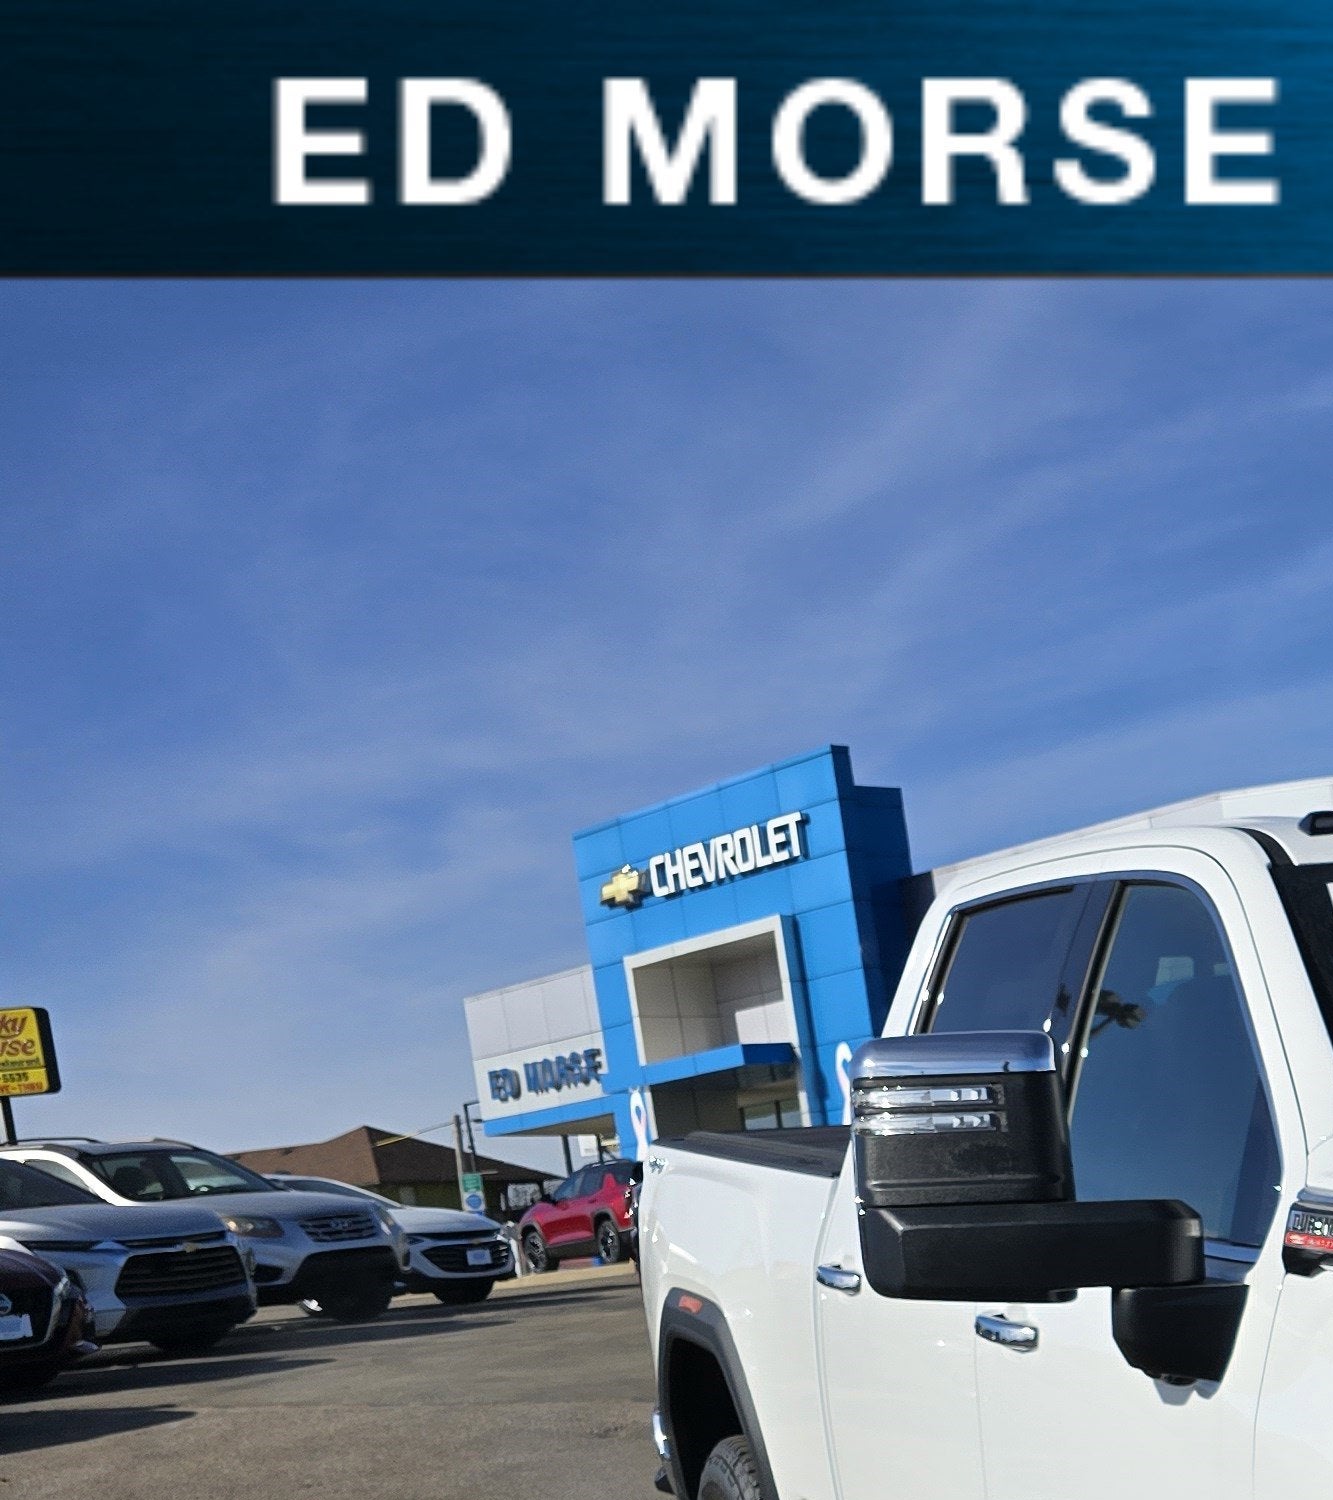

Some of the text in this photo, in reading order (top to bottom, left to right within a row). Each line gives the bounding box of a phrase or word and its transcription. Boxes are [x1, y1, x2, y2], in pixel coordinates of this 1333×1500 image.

[649, 811, 803, 898] CHEVROLET
[488, 1048, 602, 1101] ED MORSE
